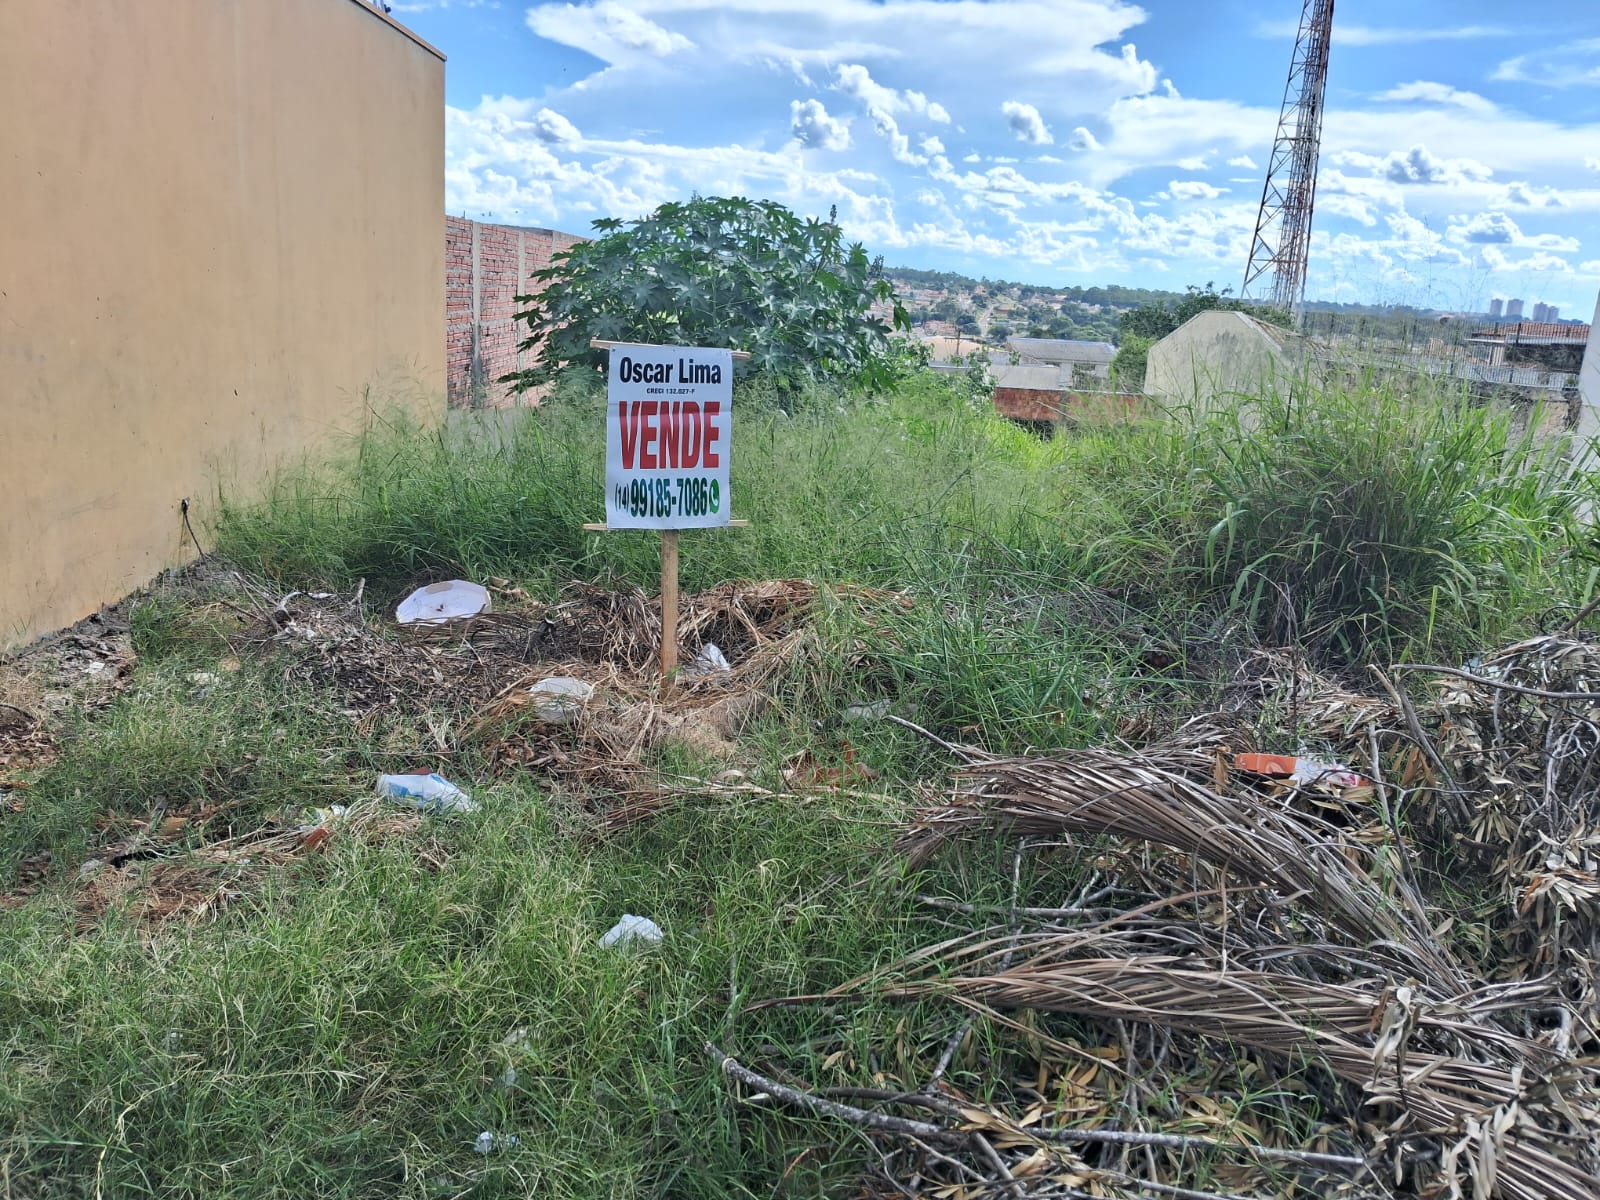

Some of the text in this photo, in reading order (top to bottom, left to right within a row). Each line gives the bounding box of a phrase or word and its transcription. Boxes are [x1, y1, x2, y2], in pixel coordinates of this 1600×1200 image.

[620, 357, 721, 384] Oscar Lima
[619, 401, 720, 470] VENDE
